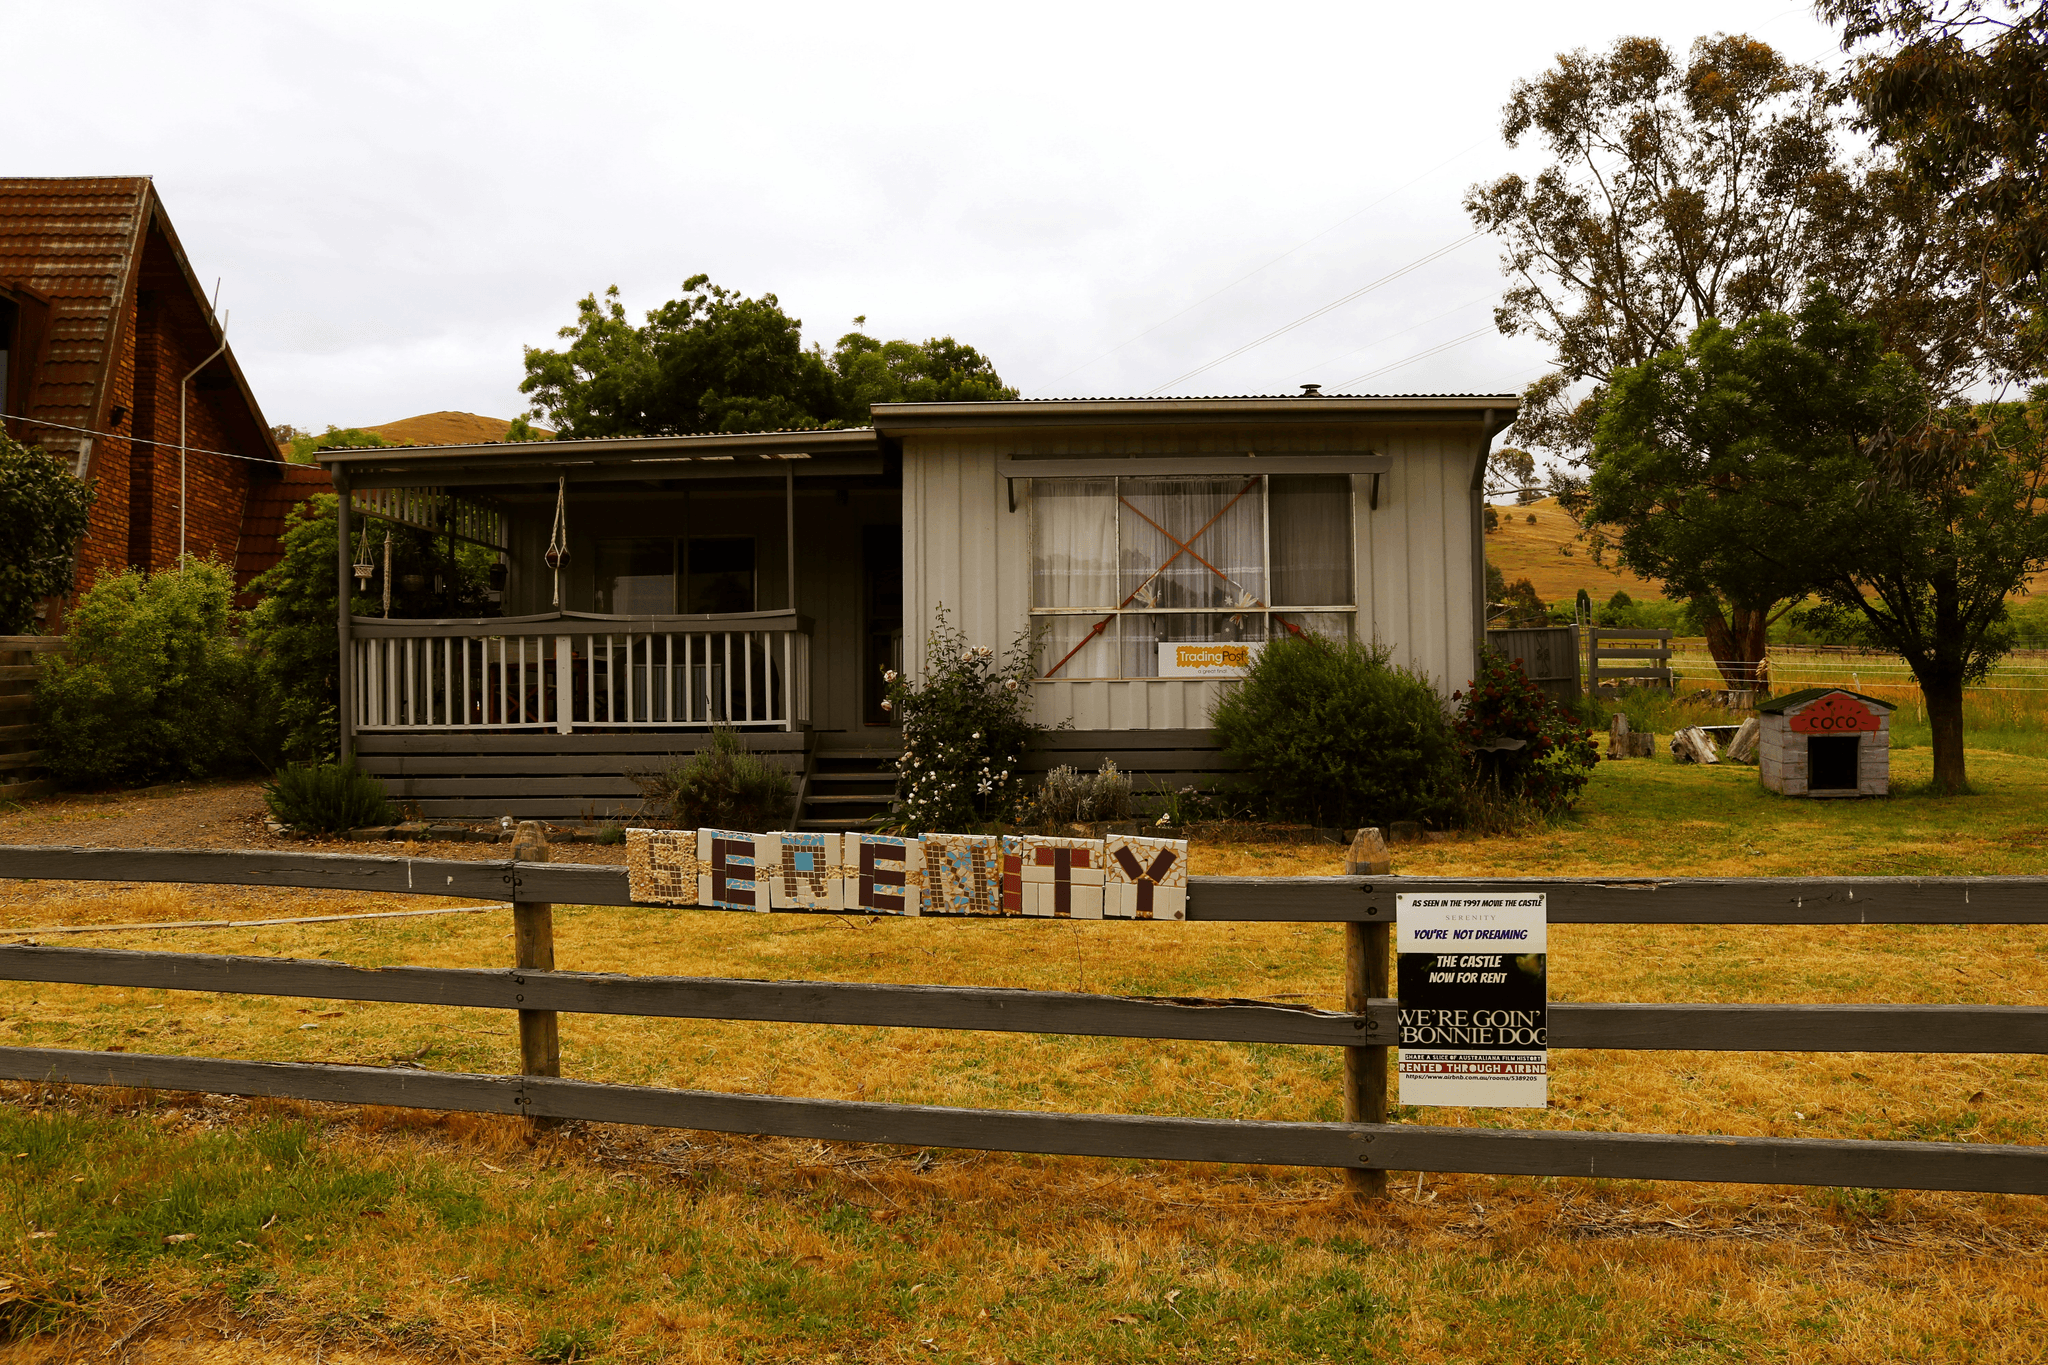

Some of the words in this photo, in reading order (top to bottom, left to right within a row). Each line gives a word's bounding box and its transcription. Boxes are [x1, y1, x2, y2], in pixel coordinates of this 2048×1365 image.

[646, 835, 1180, 919] SERENITY
[1414, 929, 1448, 940] YOU'RE
[1453, 930, 1474, 940] NOT
[1475, 930, 1528, 940] DREAMING
[1436, 955, 1458, 968] THE
[1459, 955, 1503, 968] CASTLE
[1428, 972, 1456, 983] NOW
[1456, 972, 1479, 984] FOR
[1479, 972, 1508, 984] RENT
[1402, 1026, 1494, 1044] BONNIE
[1399, 1063, 1443, 1072] RENTED
[1446, 1063, 1501, 1073] THROUGH
[1505, 1064, 1546, 1073] AIRBNB
